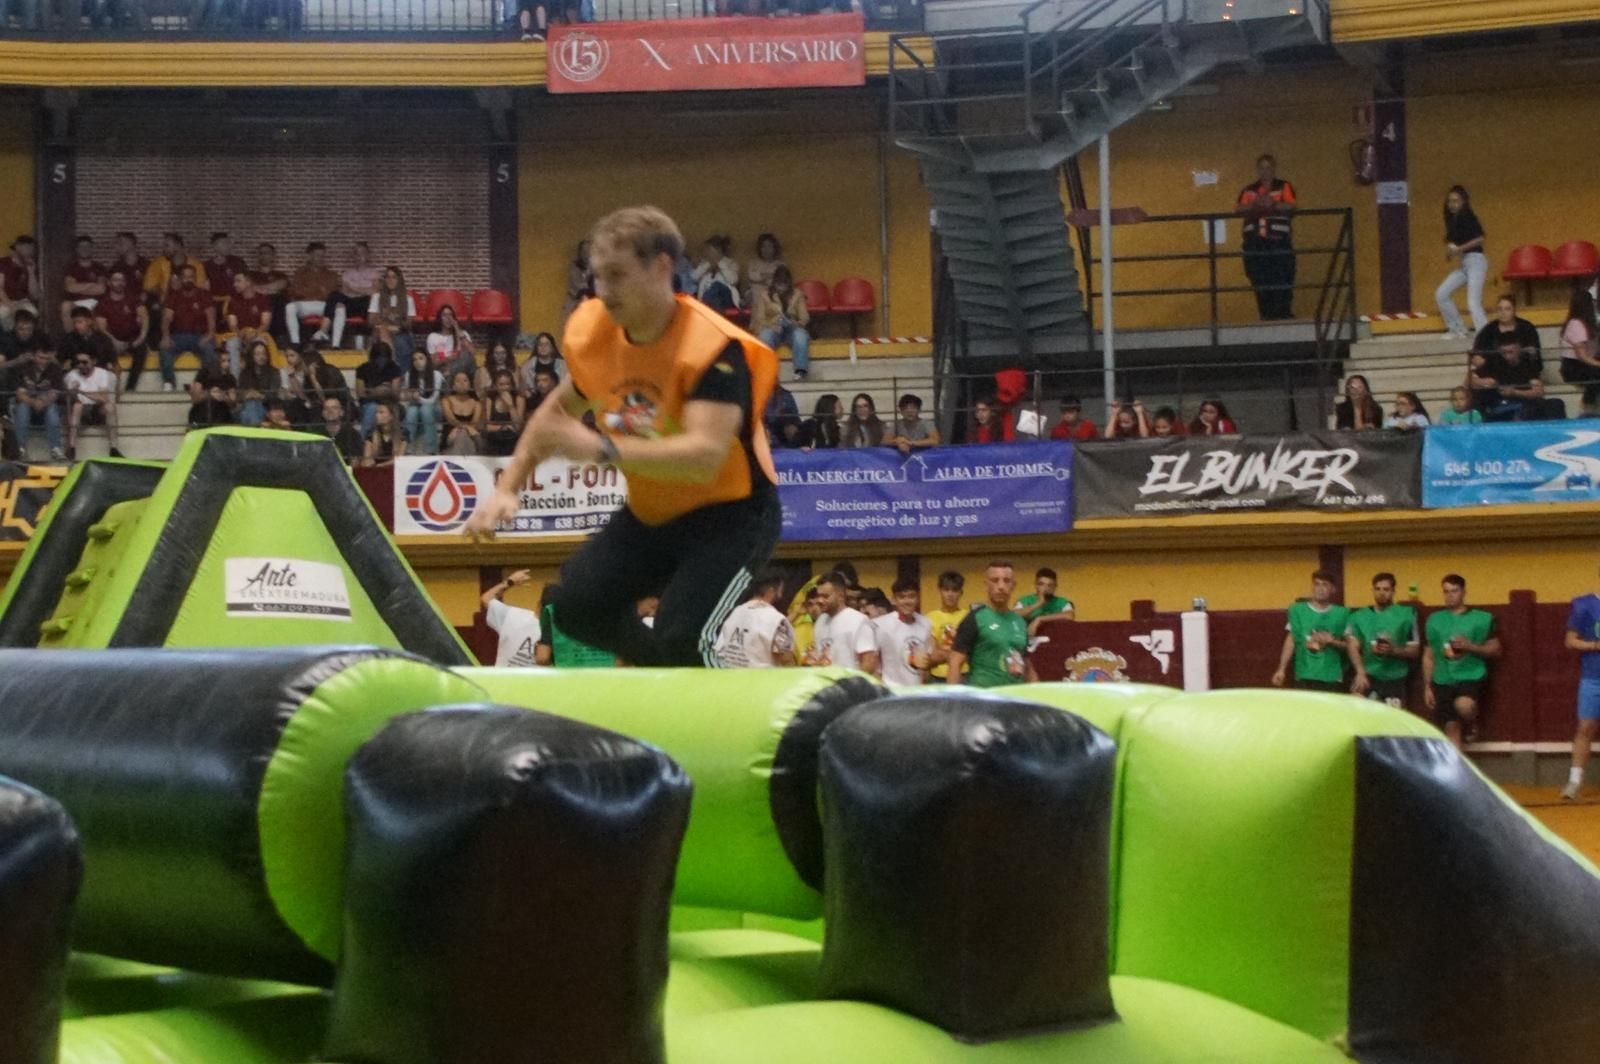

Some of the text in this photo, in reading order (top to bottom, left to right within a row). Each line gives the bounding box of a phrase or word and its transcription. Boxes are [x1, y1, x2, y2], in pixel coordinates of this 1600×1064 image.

[637, 38, 858, 70] X ANIVERSARIO
[1382, 122, 1396, 141] 4
[53, 164, 67, 183] 5
[496, 162, 510, 183] 5
[806, 467, 896, 482] ENERGÉTICA
[935, 462, 1054, 480] ALBA DE TORMES
[1137, 437, 1359, 505] EL BUNKER
[1475, 460, 1503, 475] 400
[520, 493, 577, 510] facción
[587, 491, 625, 507] fonta
[815, 496, 990, 513] Soluciones para tu ahorro
[826, 513, 978, 530] energético de luz y gas
[236, 561, 297, 592] Arte
